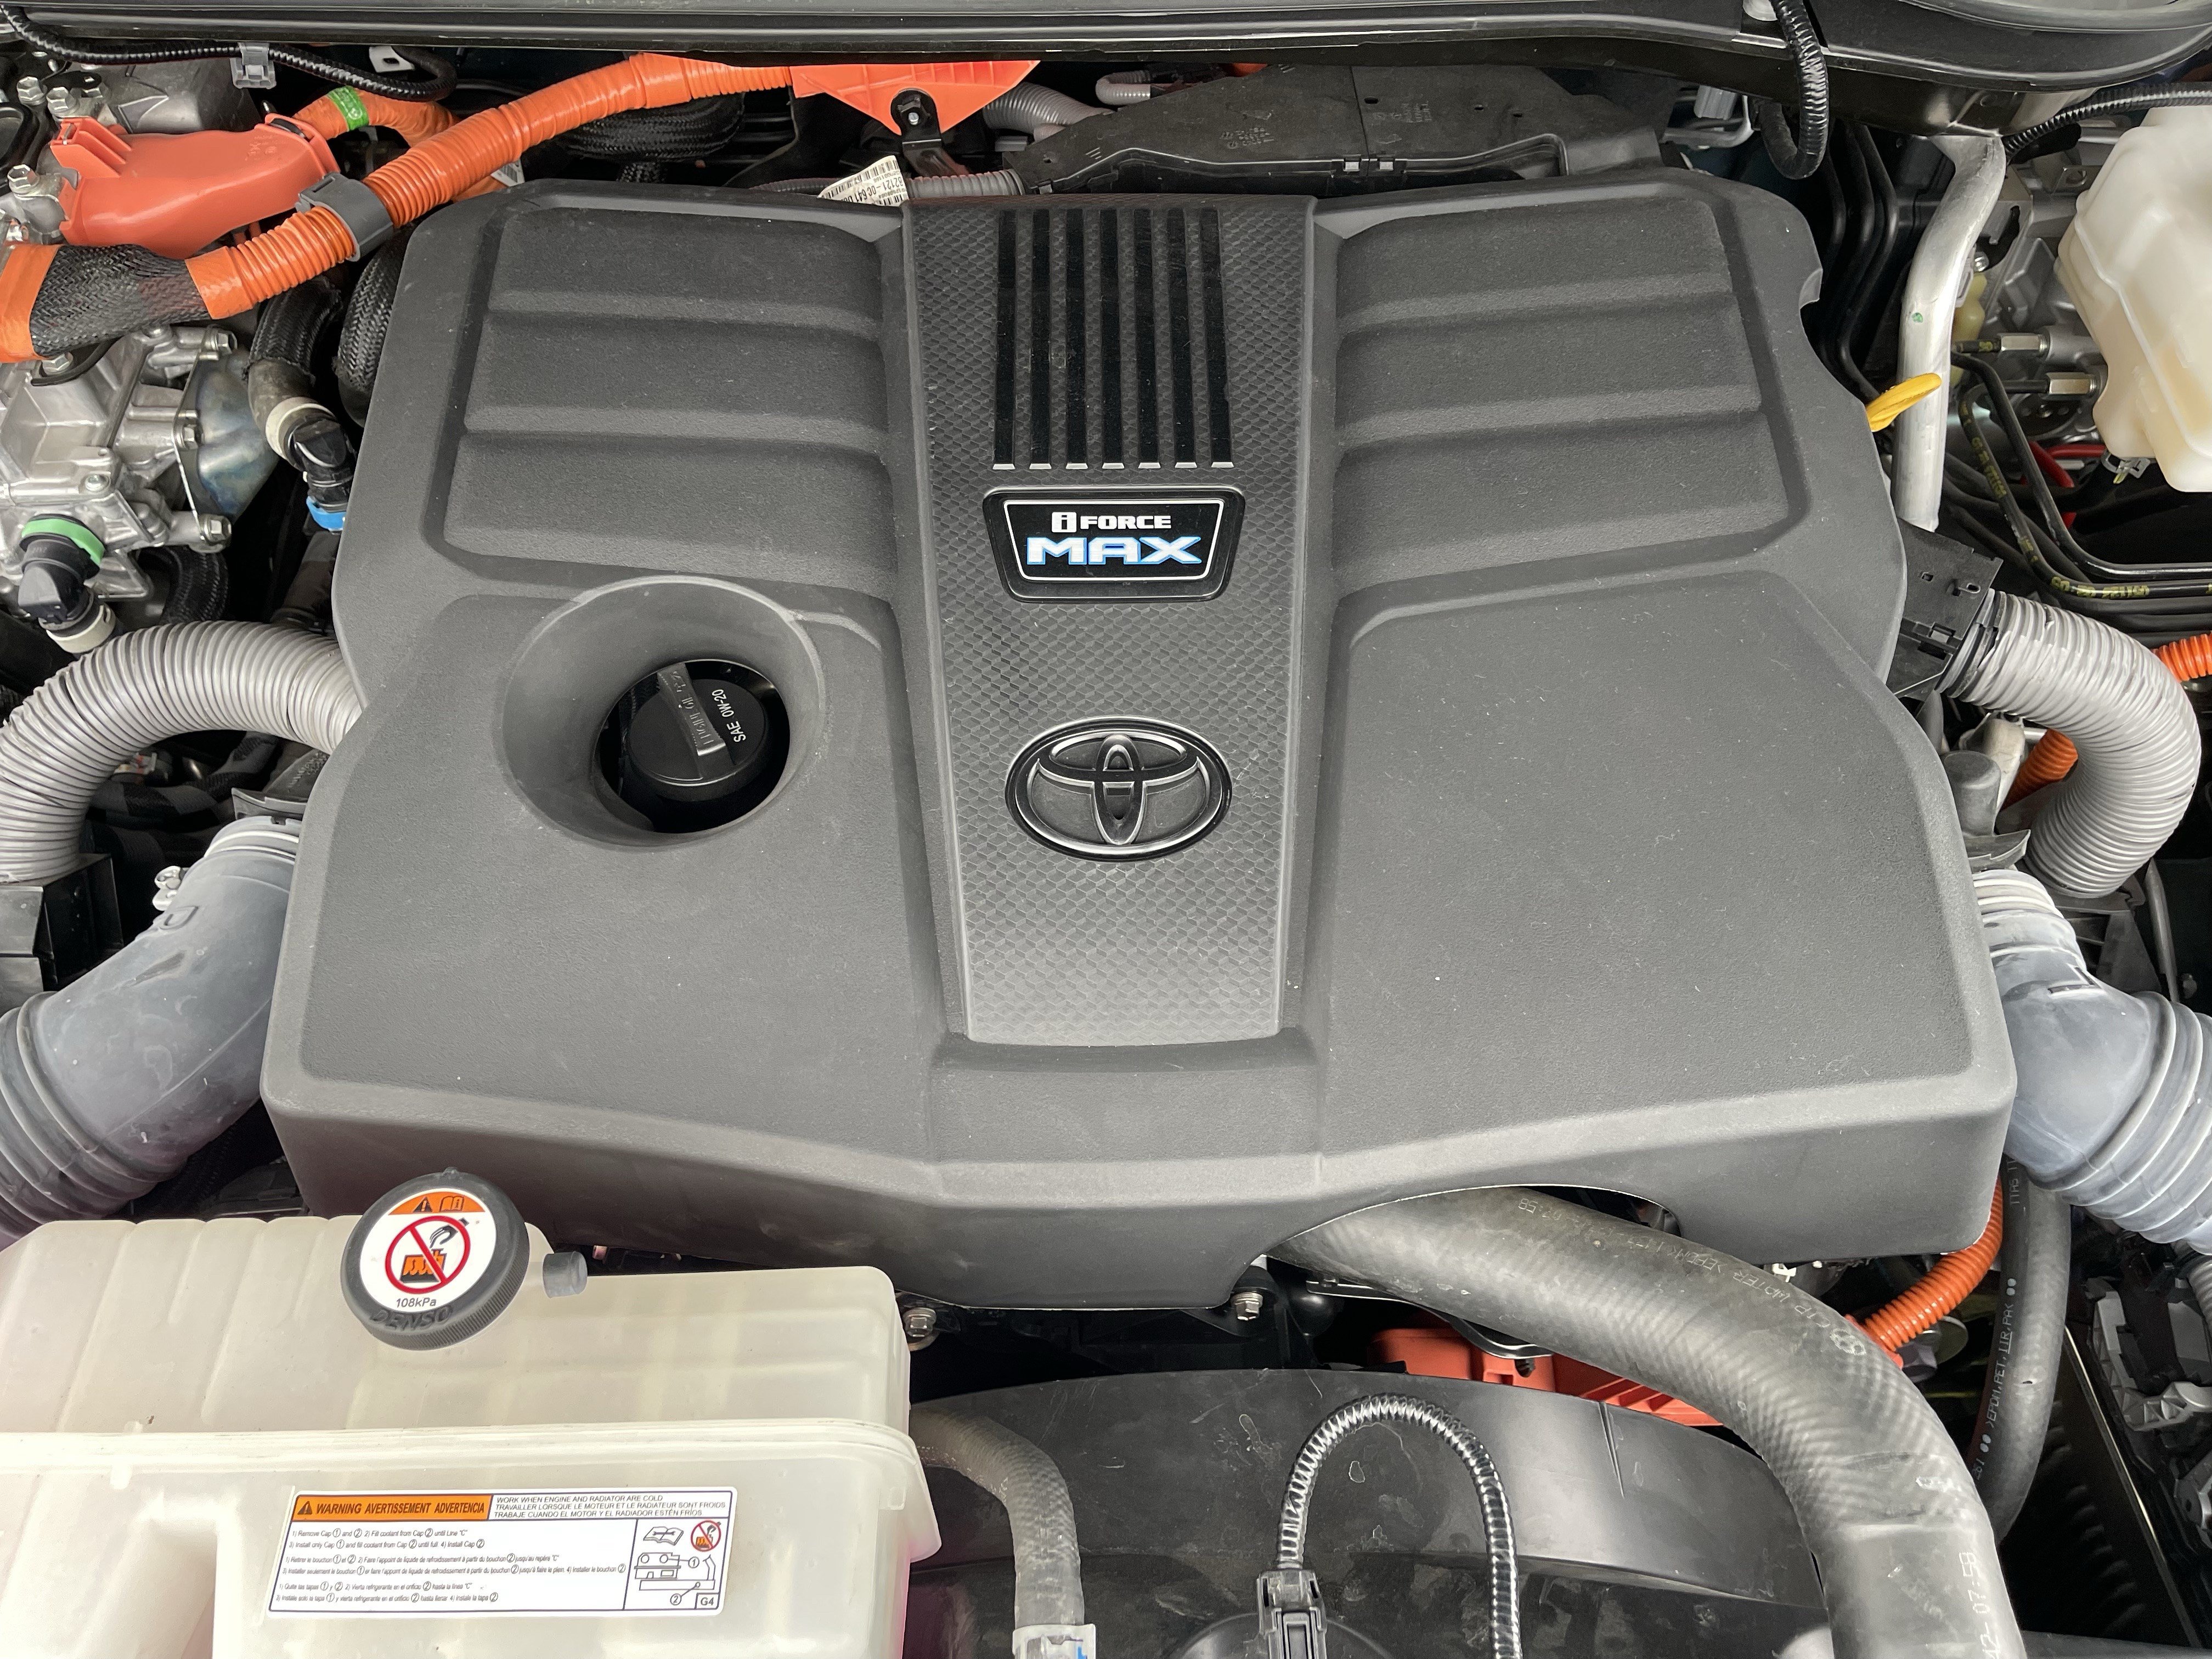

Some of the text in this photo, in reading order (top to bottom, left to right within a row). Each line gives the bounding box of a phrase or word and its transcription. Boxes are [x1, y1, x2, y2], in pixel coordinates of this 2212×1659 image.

[1026, 535, 1202, 565] MAX
[711, 689, 747, 743] SAE 0W-20
[396, 1297, 437, 1308] 108kPa
[369, 1305, 453, 1330] DENSO
[316, 1502, 484, 1514] WARNING AVERTISSEMENT ADVERTENCIA
[700, 1597, 714, 1606] G4
